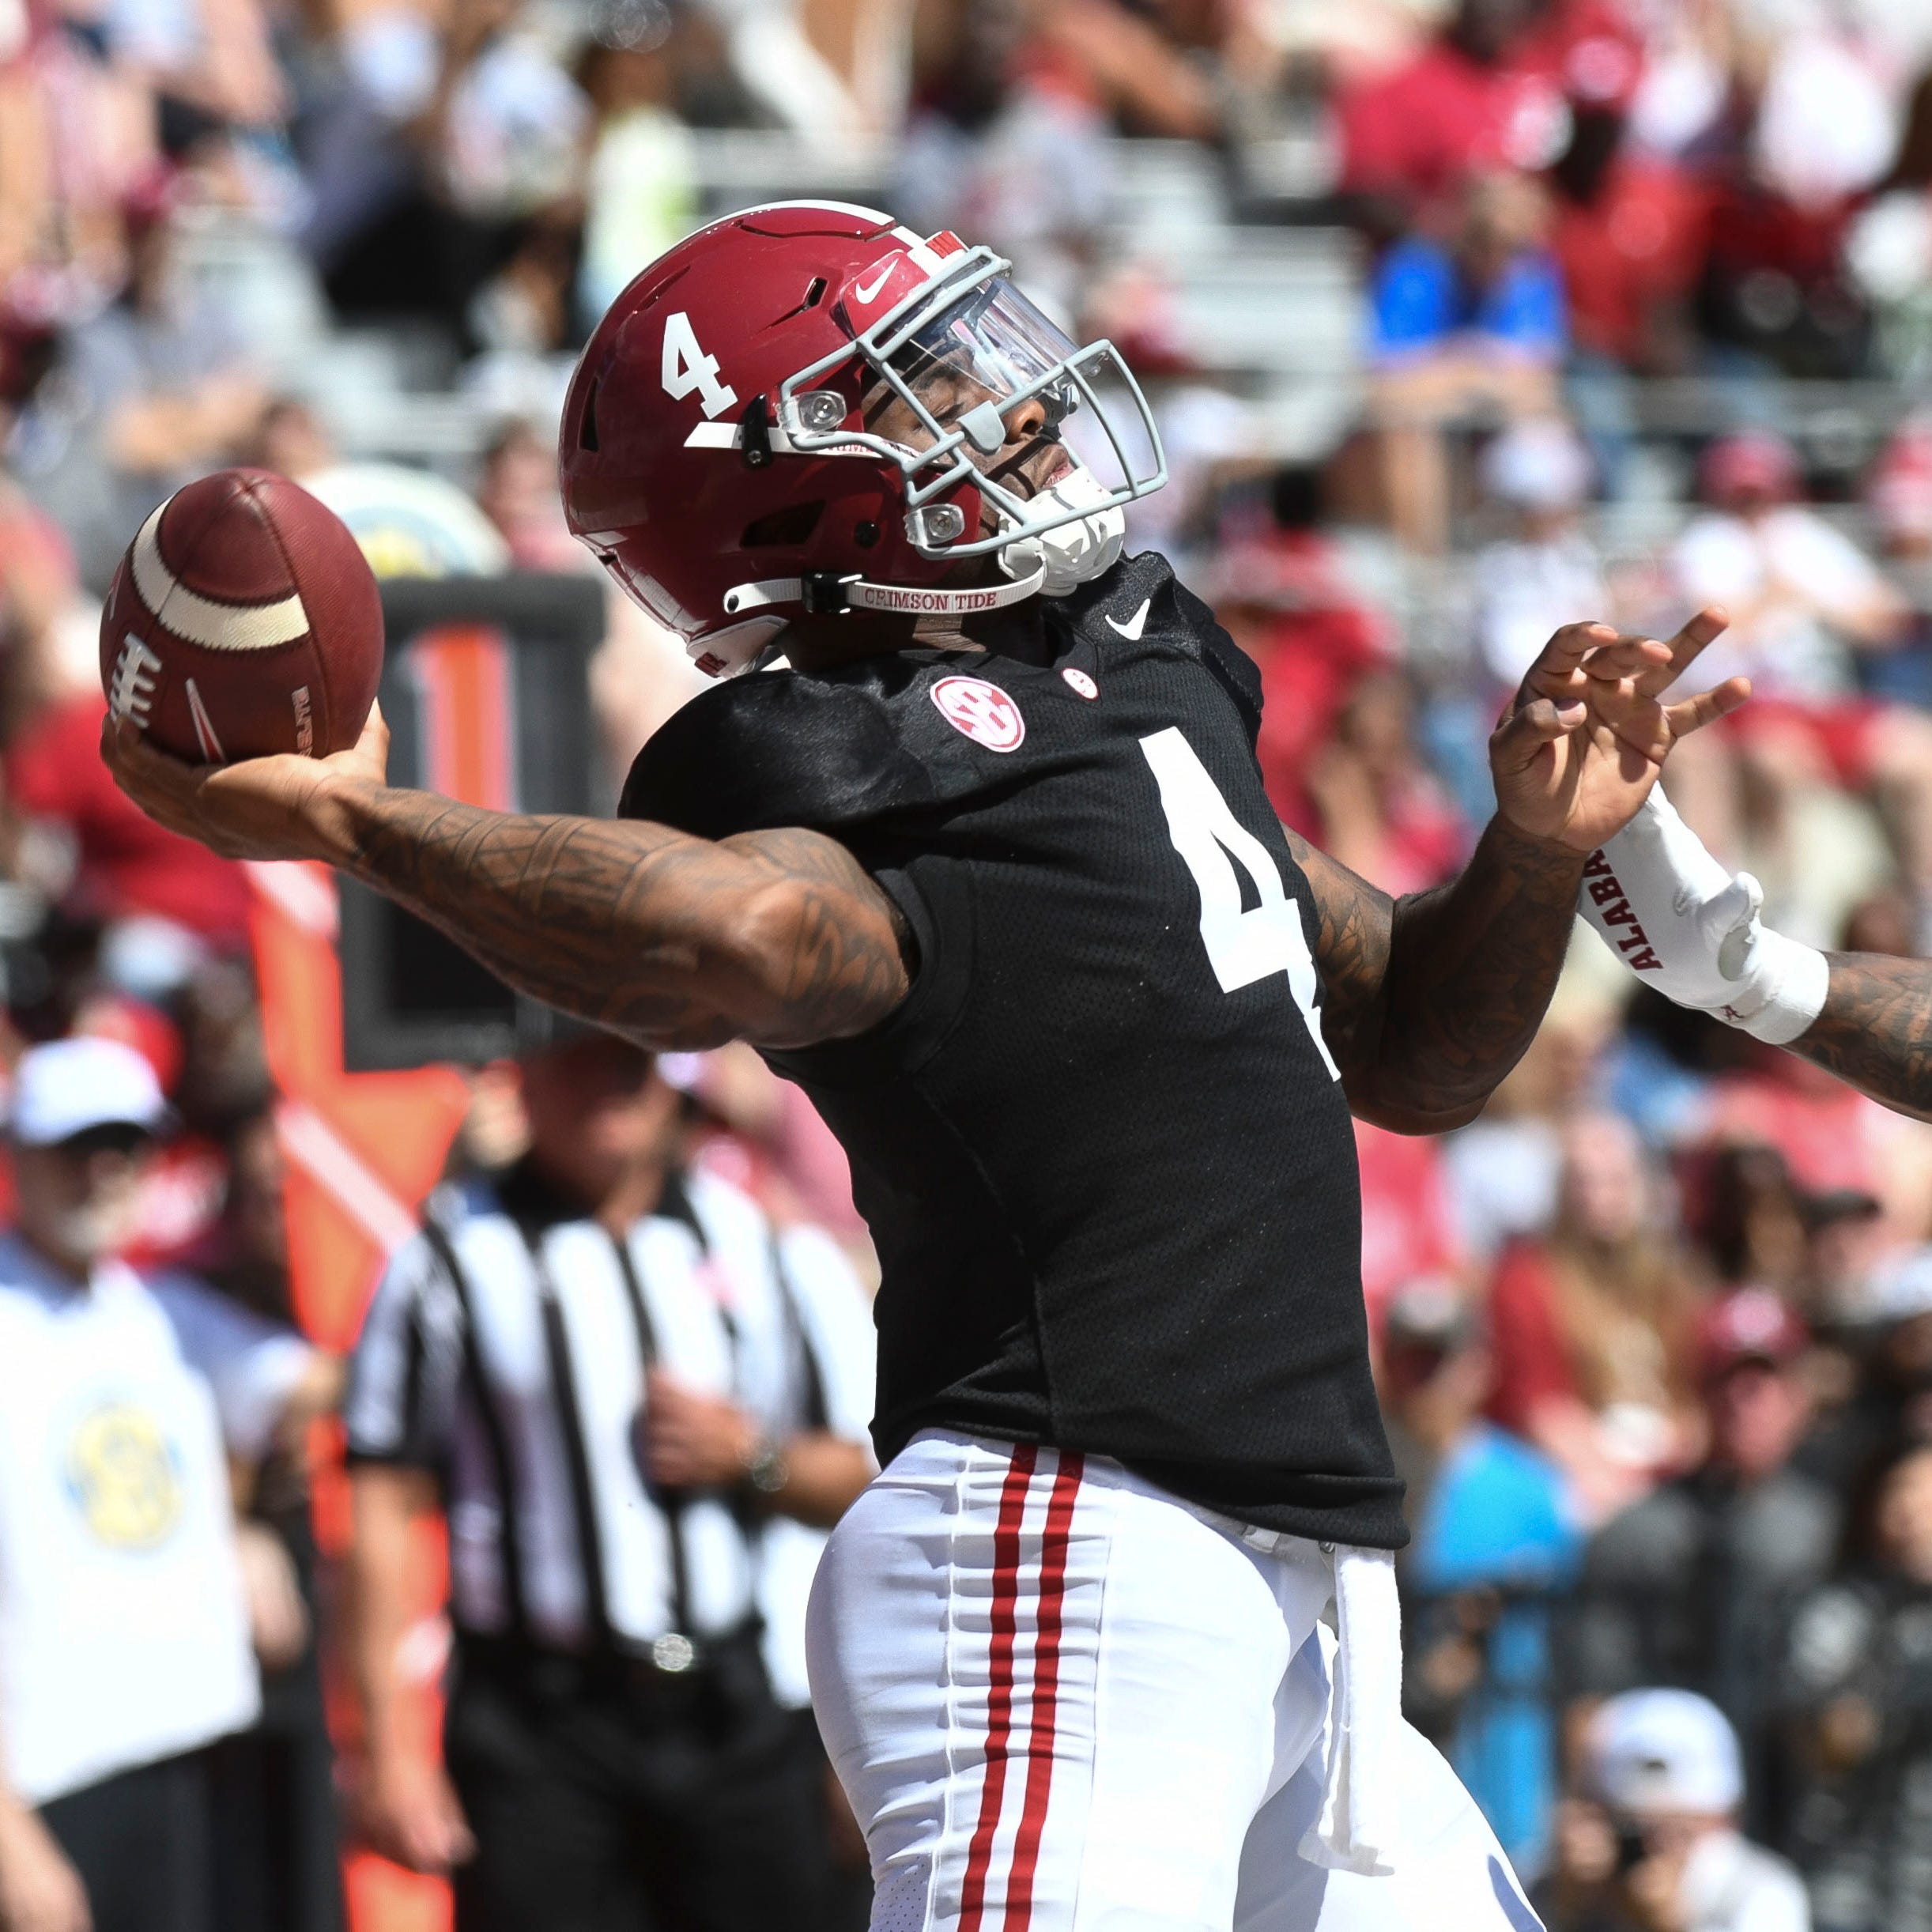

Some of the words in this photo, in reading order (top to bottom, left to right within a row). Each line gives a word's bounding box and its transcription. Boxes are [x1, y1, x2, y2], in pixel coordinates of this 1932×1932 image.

[662, 311, 738, 420] 4
[865, 588, 949, 610] CRIMSON
[955, 591, 997, 610] TIDE
[1138, 726, 1341, 1082] 4
